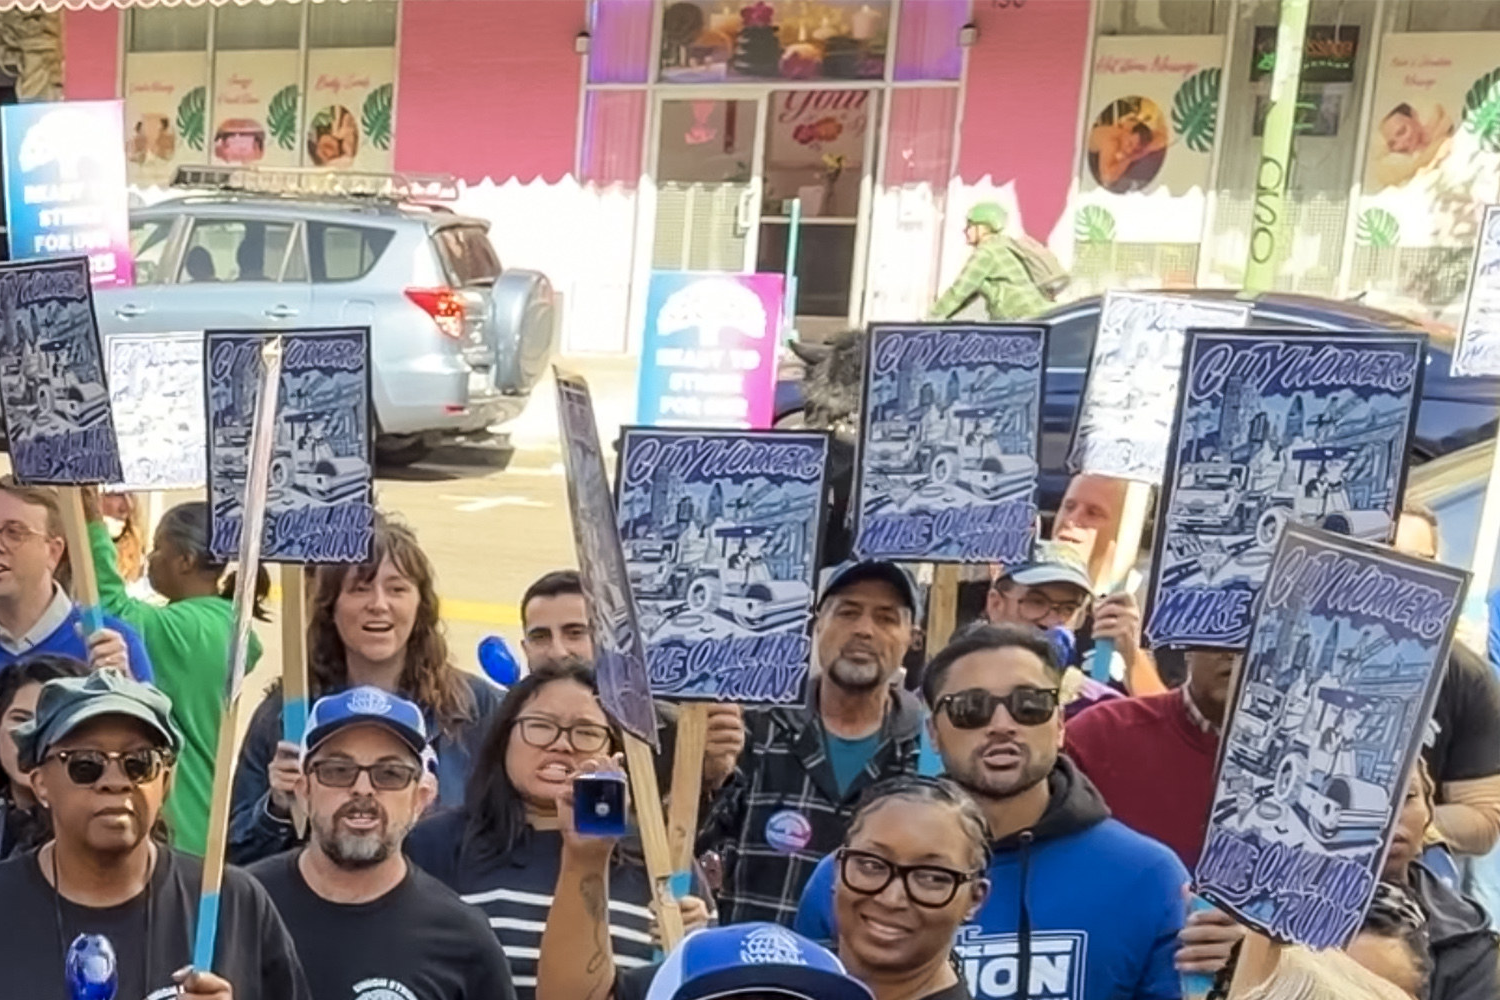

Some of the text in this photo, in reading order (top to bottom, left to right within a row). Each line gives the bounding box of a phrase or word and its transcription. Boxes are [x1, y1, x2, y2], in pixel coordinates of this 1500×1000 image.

[1189, 341, 1415, 400] CITY WORKERS
[625, 436, 824, 489] CITY WORKERS
[1146, 587, 1253, 635] MAKE
[1265, 543, 1455, 642] CITY WORKERS
[688, 631, 810, 676] OAKLAND
